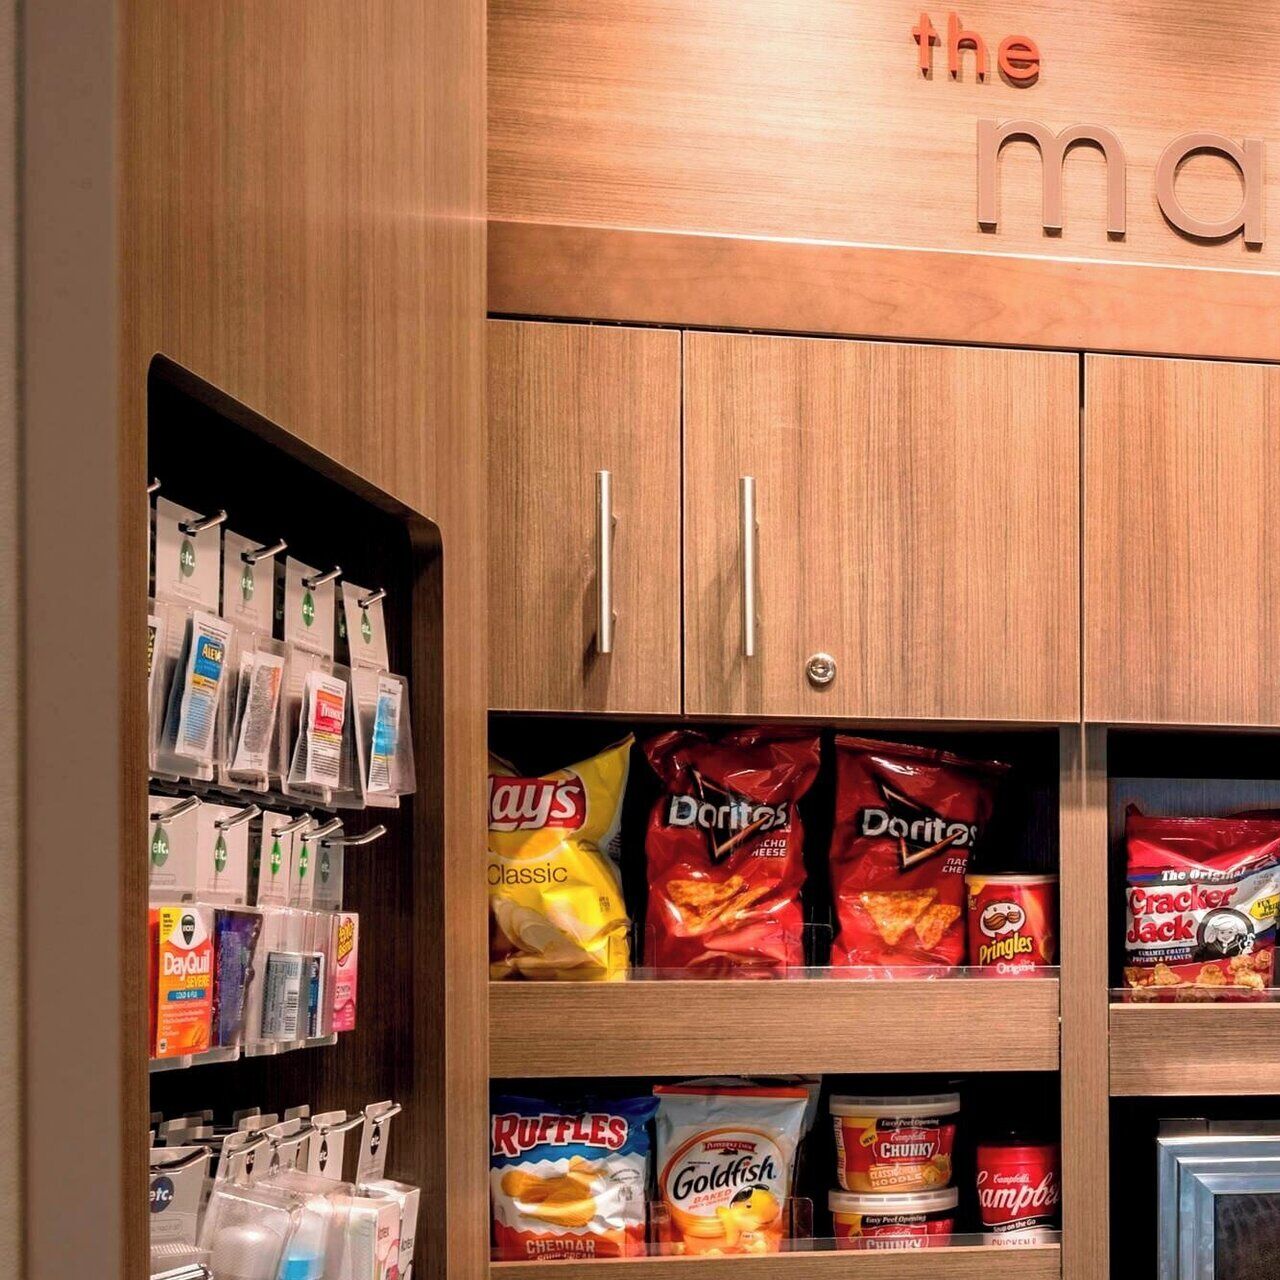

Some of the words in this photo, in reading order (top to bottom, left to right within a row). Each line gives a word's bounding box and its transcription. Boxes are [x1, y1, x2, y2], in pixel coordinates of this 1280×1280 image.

[912, 13, 1040, 82] the
[668, 795, 787, 830] Doritos
[488, 863, 568, 885] Classic
[1161, 871, 1185, 881] The
[1129, 884, 1238, 915] Cracker
[1128, 915, 1194, 943] Jack
[979, 931, 1033, 970] Pringles
[164, 951, 210, 981] DayQuil
[492, 1112, 628, 1158] RUFFLES
[881, 1119, 898, 1127] Easy
[900, 1119, 914, 1128] Peel
[880, 1142, 935, 1159] CHUNKY
[673, 1155, 777, 1201] Goldfish
[872, 1173, 923, 1187] NOODLE
[866, 1215, 881, 1224] Easy
[882, 1214, 898, 1223] Peel
[898, 1213, 927, 1223] Opening
[526, 1239, 596, 1254] CHEDDAR
